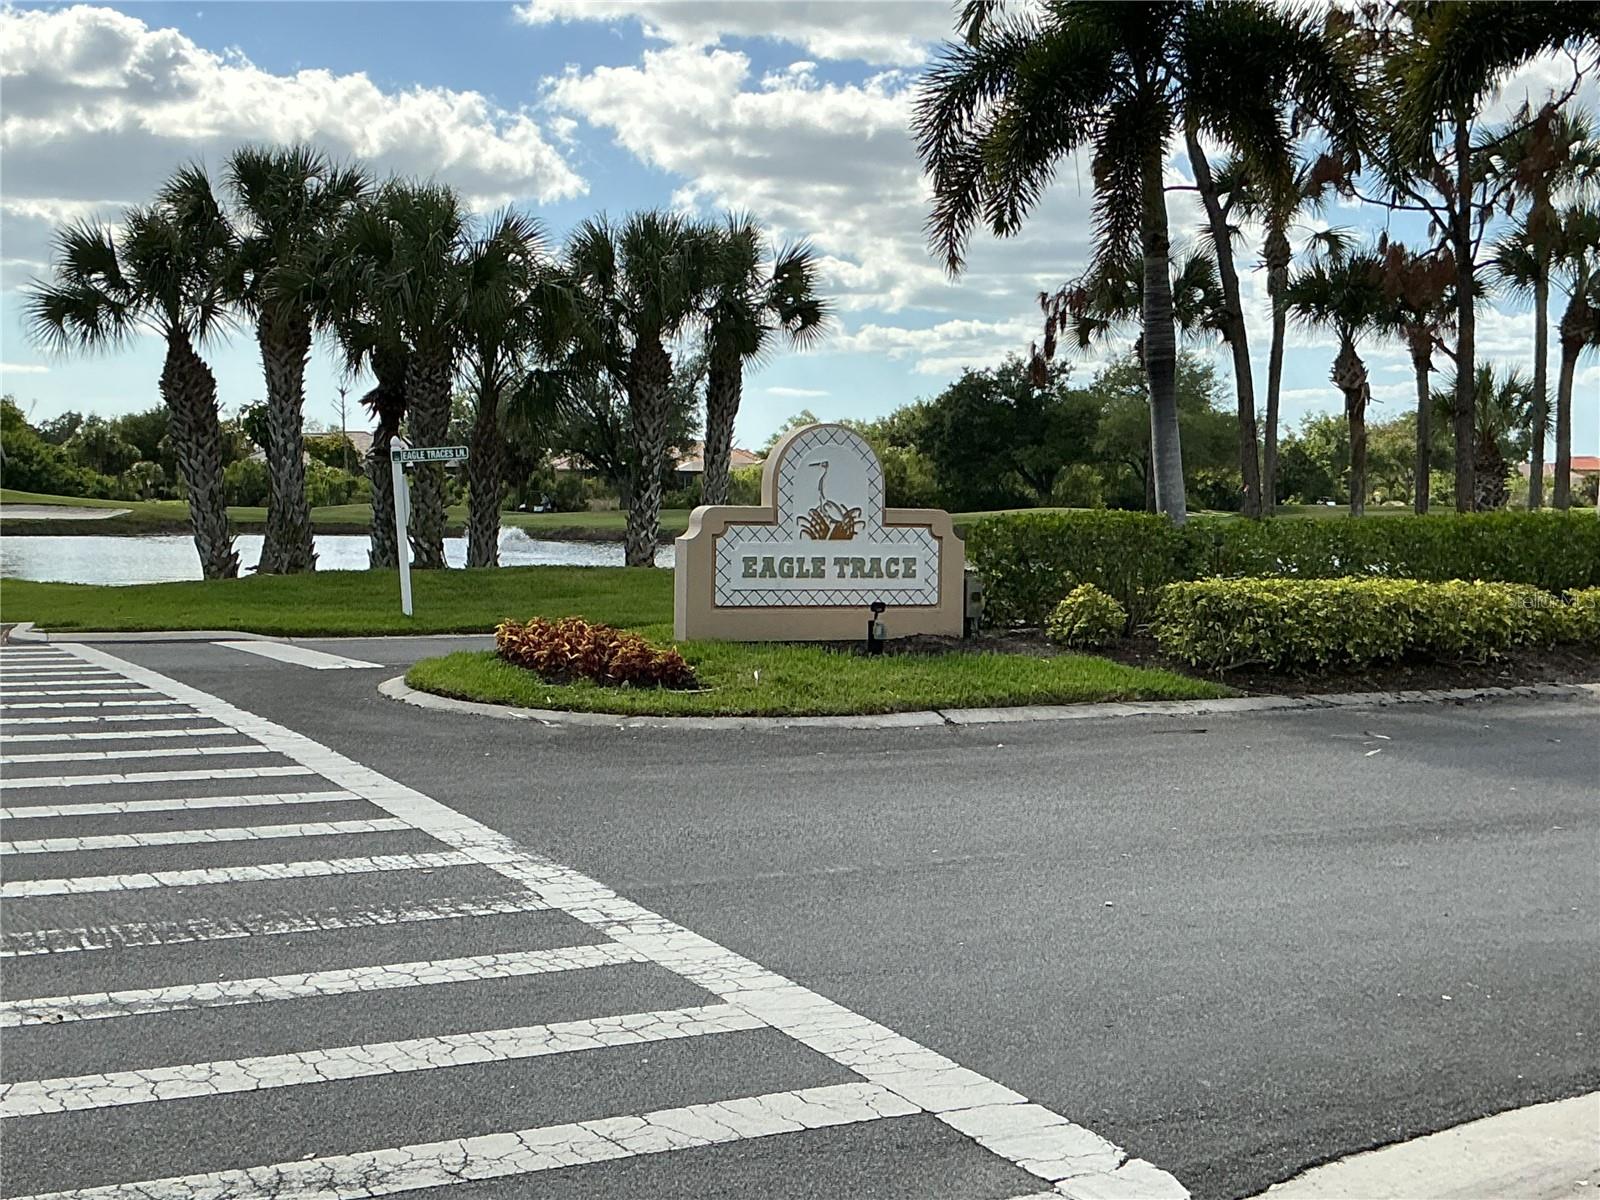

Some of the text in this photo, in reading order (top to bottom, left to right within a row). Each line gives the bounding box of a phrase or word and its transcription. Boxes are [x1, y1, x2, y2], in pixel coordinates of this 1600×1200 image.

[402, 451, 425, 460] EAGLE
[427, 449, 454, 459] TRACES
[741, 556, 917, 579] EAGLE TRACE
